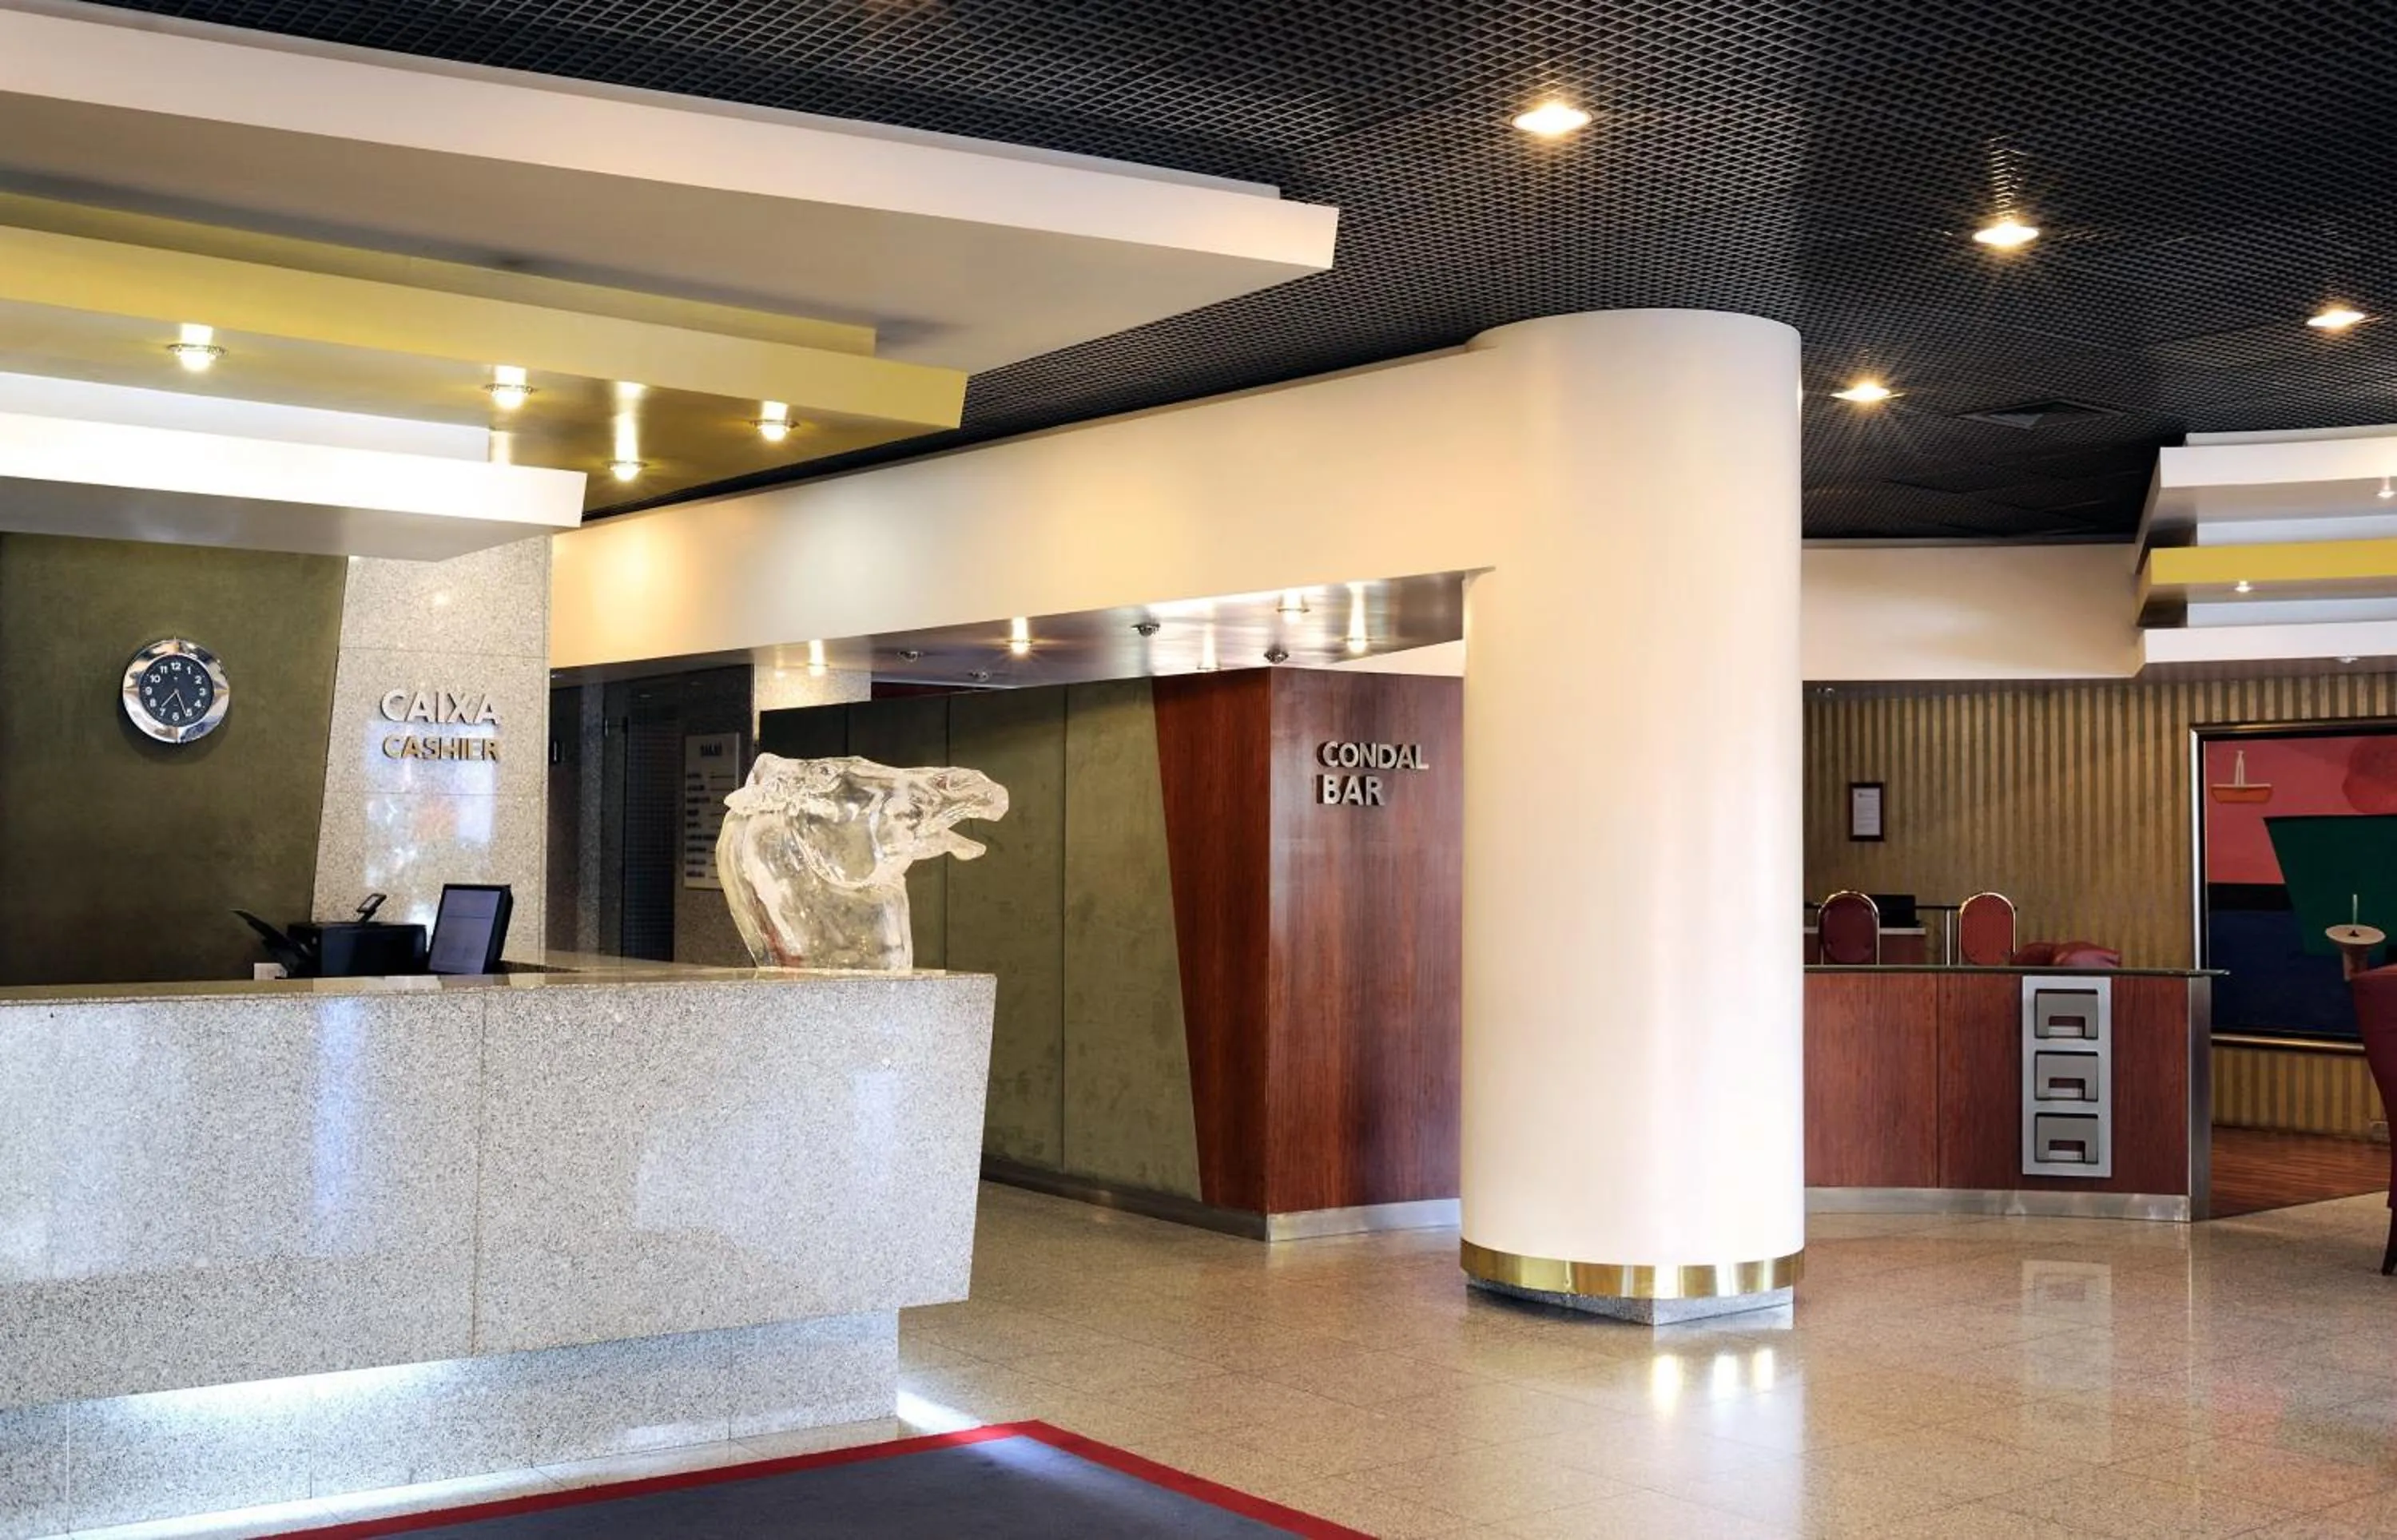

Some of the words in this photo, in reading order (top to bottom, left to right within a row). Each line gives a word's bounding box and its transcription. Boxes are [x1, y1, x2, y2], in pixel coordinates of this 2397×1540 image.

[160, 665, 168, 674] 11
[170, 661, 181, 671] 12
[186, 665, 192, 675] 1
[149, 674, 161, 683] 10
[194, 675, 202, 685] 2
[145, 686, 153, 696] 9
[199, 687, 206, 697] 3
[149, 697, 157, 708] 8
[194, 699, 202, 708] 4
[380, 688, 500, 726] CAIXA
[160, 707, 166, 716] 7
[172, 712, 180, 721] 6
[185, 708, 193, 717] 5
[383, 733, 499, 763] CASHIER
[1322, 740, 1429, 770] CONDAL
[1322, 774, 1385, 806] BAR
